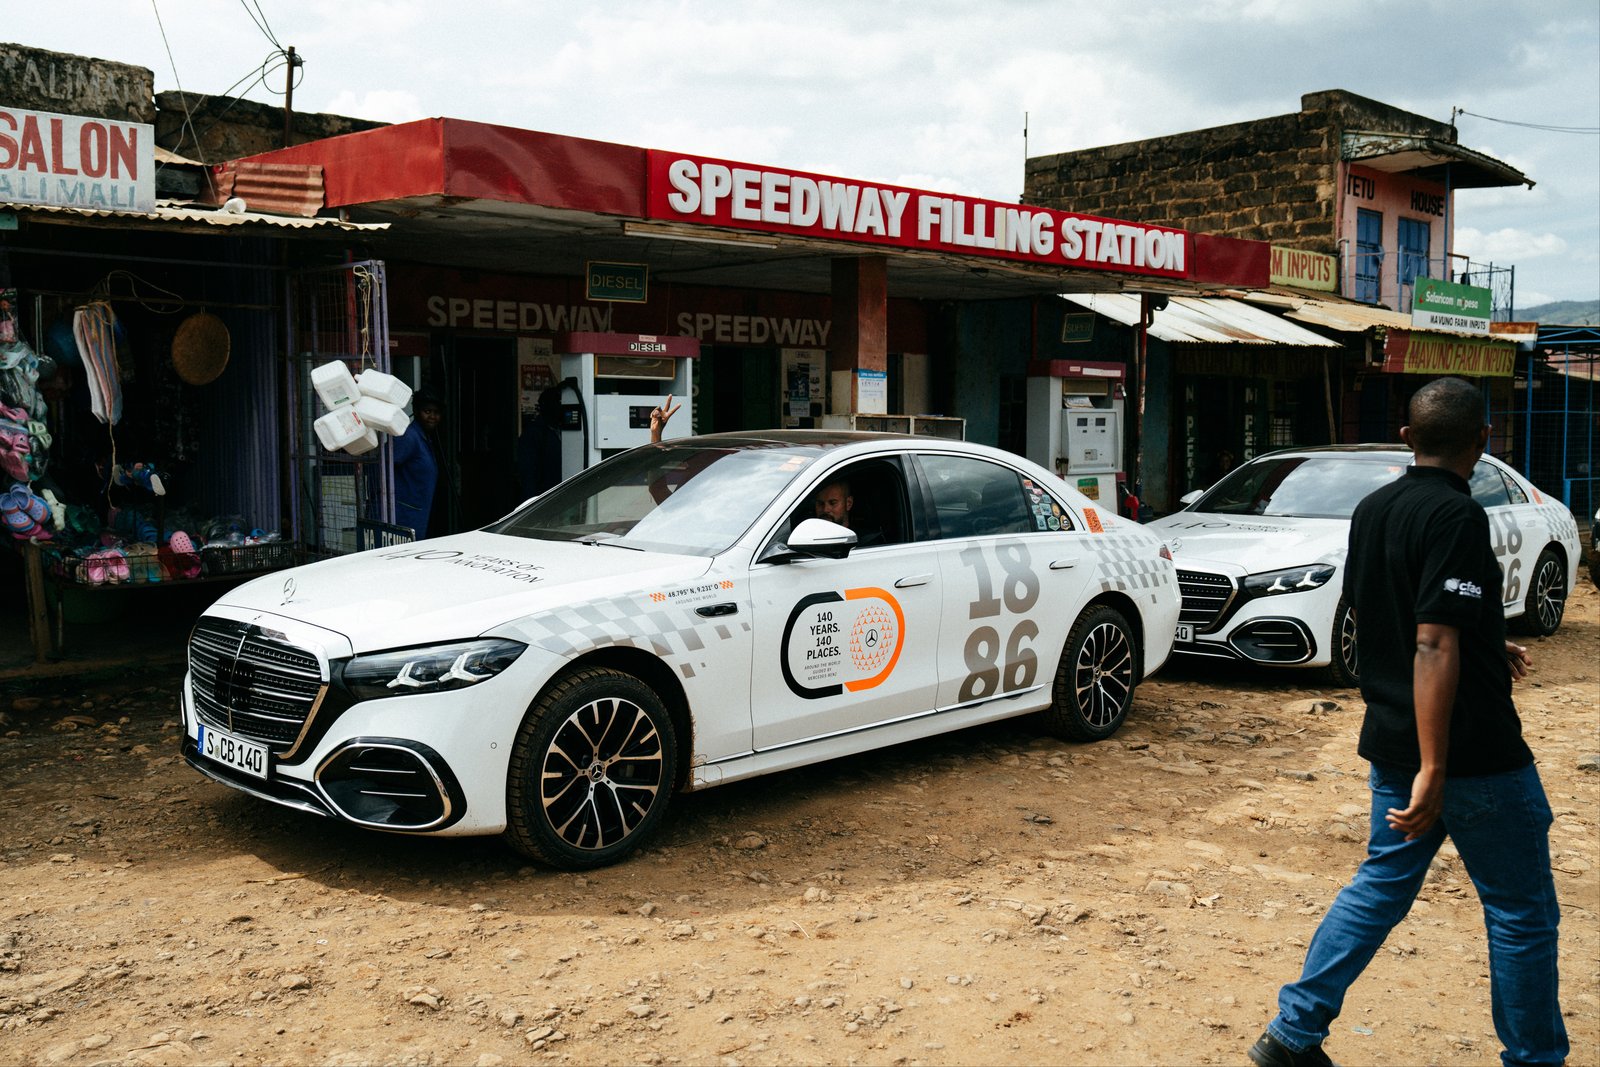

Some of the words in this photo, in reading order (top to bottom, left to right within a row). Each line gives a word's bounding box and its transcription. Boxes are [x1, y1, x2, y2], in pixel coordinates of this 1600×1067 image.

[0, 111, 138, 181] SALON
[1346, 173, 1375, 200] TETU
[1410, 190, 1445, 217] HOUSE
[668, 160, 910, 238] SPEEDWAY
[918, 195, 1054, 256] FILLING
[1061, 217, 1185, 272] STATION
[1270, 249, 1283, 276] M
[1287, 251, 1331, 283] INPUTS
[591, 273, 642, 290] DIESEL
[1425, 290, 1455, 306] Safaricom
[426, 295, 613, 333] SPEEDWAY
[1430, 315, 1454, 327] MAVUNO
[1454, 318, 1468, 328] FARM
[1469, 320, 1487, 330] INPUTS
[677, 312, 832, 346] SPEEDWAY
[628, 343, 666, 352] DIESEL
[1408, 341, 1454, 369] MAVUNO
[1453, 344, 1483, 371] FARM
[1481, 346, 1515, 373] INPUTS
[381, 531, 412, 548] DENN
[445, 558, 545, 584] INNOVATION
[516, 563, 545, 571] OF
[959, 538, 1040, 620] 18
[1458, 581, 1482, 595] cfao
[1498, 558, 1523, 603] 6
[702, 593, 717, 601] WORLD
[816, 611, 833, 623] 140
[809, 622, 841, 635] YEARS.
[815, 635, 832, 648] 140
[806, 647, 842, 661] PLACES.
[958, 619, 1040, 704] 86
[207, 731, 214, 755] S
